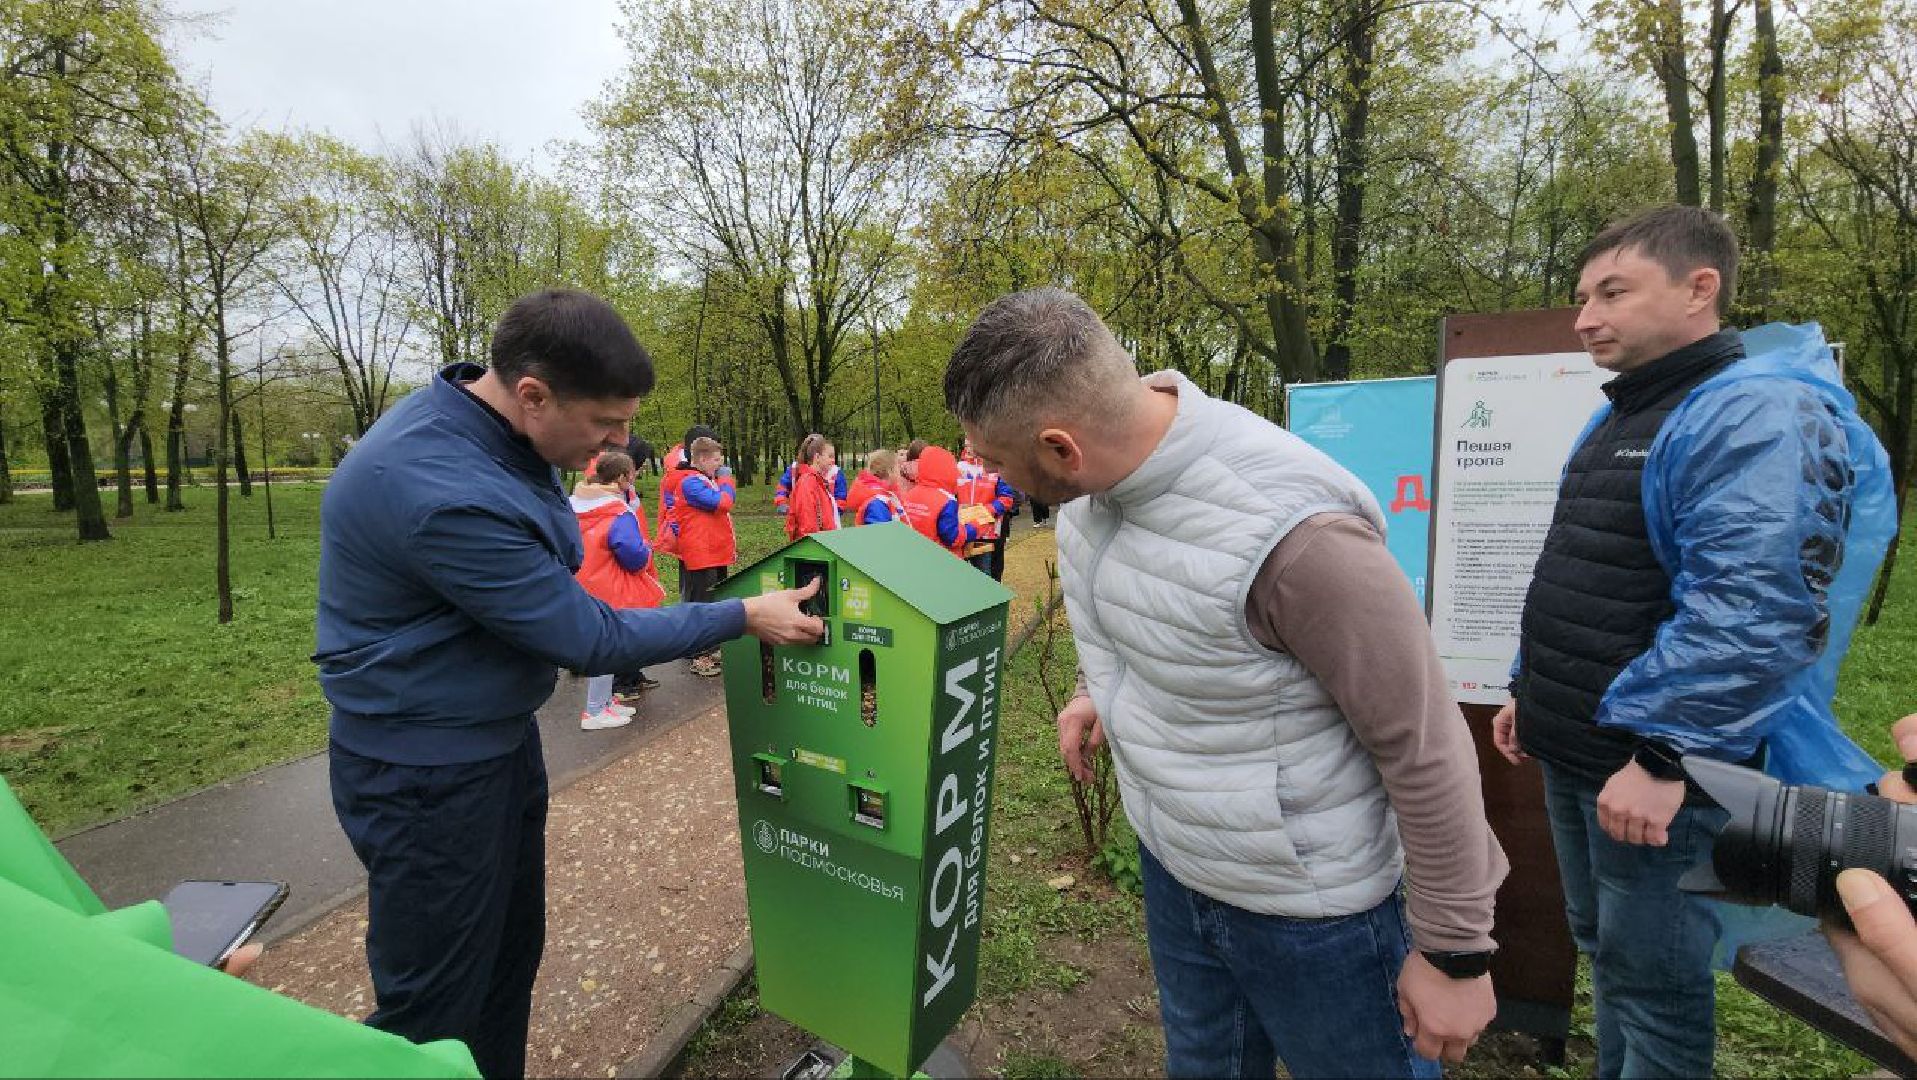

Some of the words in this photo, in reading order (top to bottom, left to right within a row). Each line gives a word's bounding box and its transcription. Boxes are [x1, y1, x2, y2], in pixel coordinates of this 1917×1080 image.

[1457, 440, 1511, 452] Пешая
[1457, 457, 1504, 470] тропа
[782, 656, 850, 684] КОРМ
[786, 679, 808, 691] для
[809, 681, 848, 700] белок
[979, 646, 1001, 732] птиц
[797, 694, 805, 704] и
[807, 695, 838, 713] птиц
[978, 737, 990, 761] и
[964, 764, 989, 870] белок
[780, 828, 830, 857] ПАРКИ
[924, 656, 980, 1009] КОРМ
[780, 845, 904, 903] ПОДМОСКОВЬЯ
[964, 870, 980, 930] для
